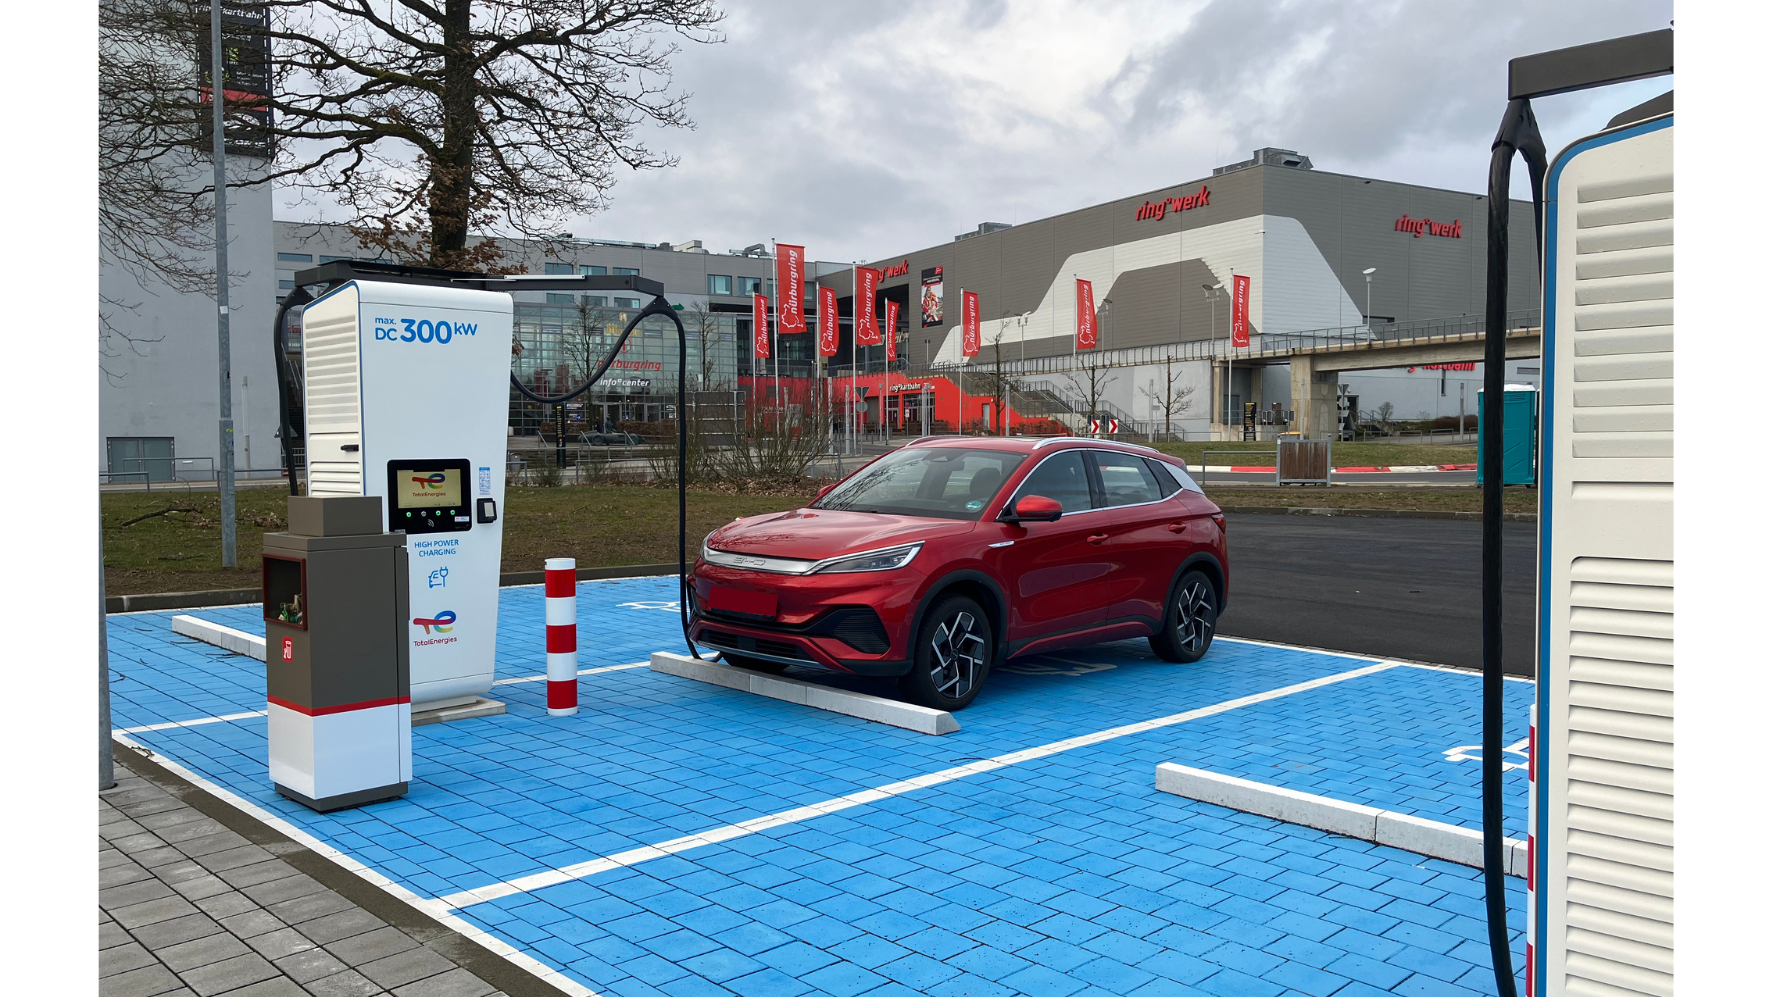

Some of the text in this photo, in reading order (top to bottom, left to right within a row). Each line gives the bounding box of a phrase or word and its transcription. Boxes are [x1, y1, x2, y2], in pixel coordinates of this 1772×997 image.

[1135, 185, 1211, 221] ring°werk
[1394, 213, 1463, 238] ring°werk
[788, 249, 799, 315] nürburgring
[878, 259, 908, 282] g°werk
[864, 272, 873, 328] nürburgring
[374, 317, 397, 325] max.
[826, 291, 835, 342] nürburgring
[375, 318, 478, 344] DC 300 kW
[598, 359, 661, 372] nrburgring
[414, 539, 459, 549] HIGH POWER
[418, 548, 456, 557] CHARGING
[413, 636, 458, 647] TotalEnergies
